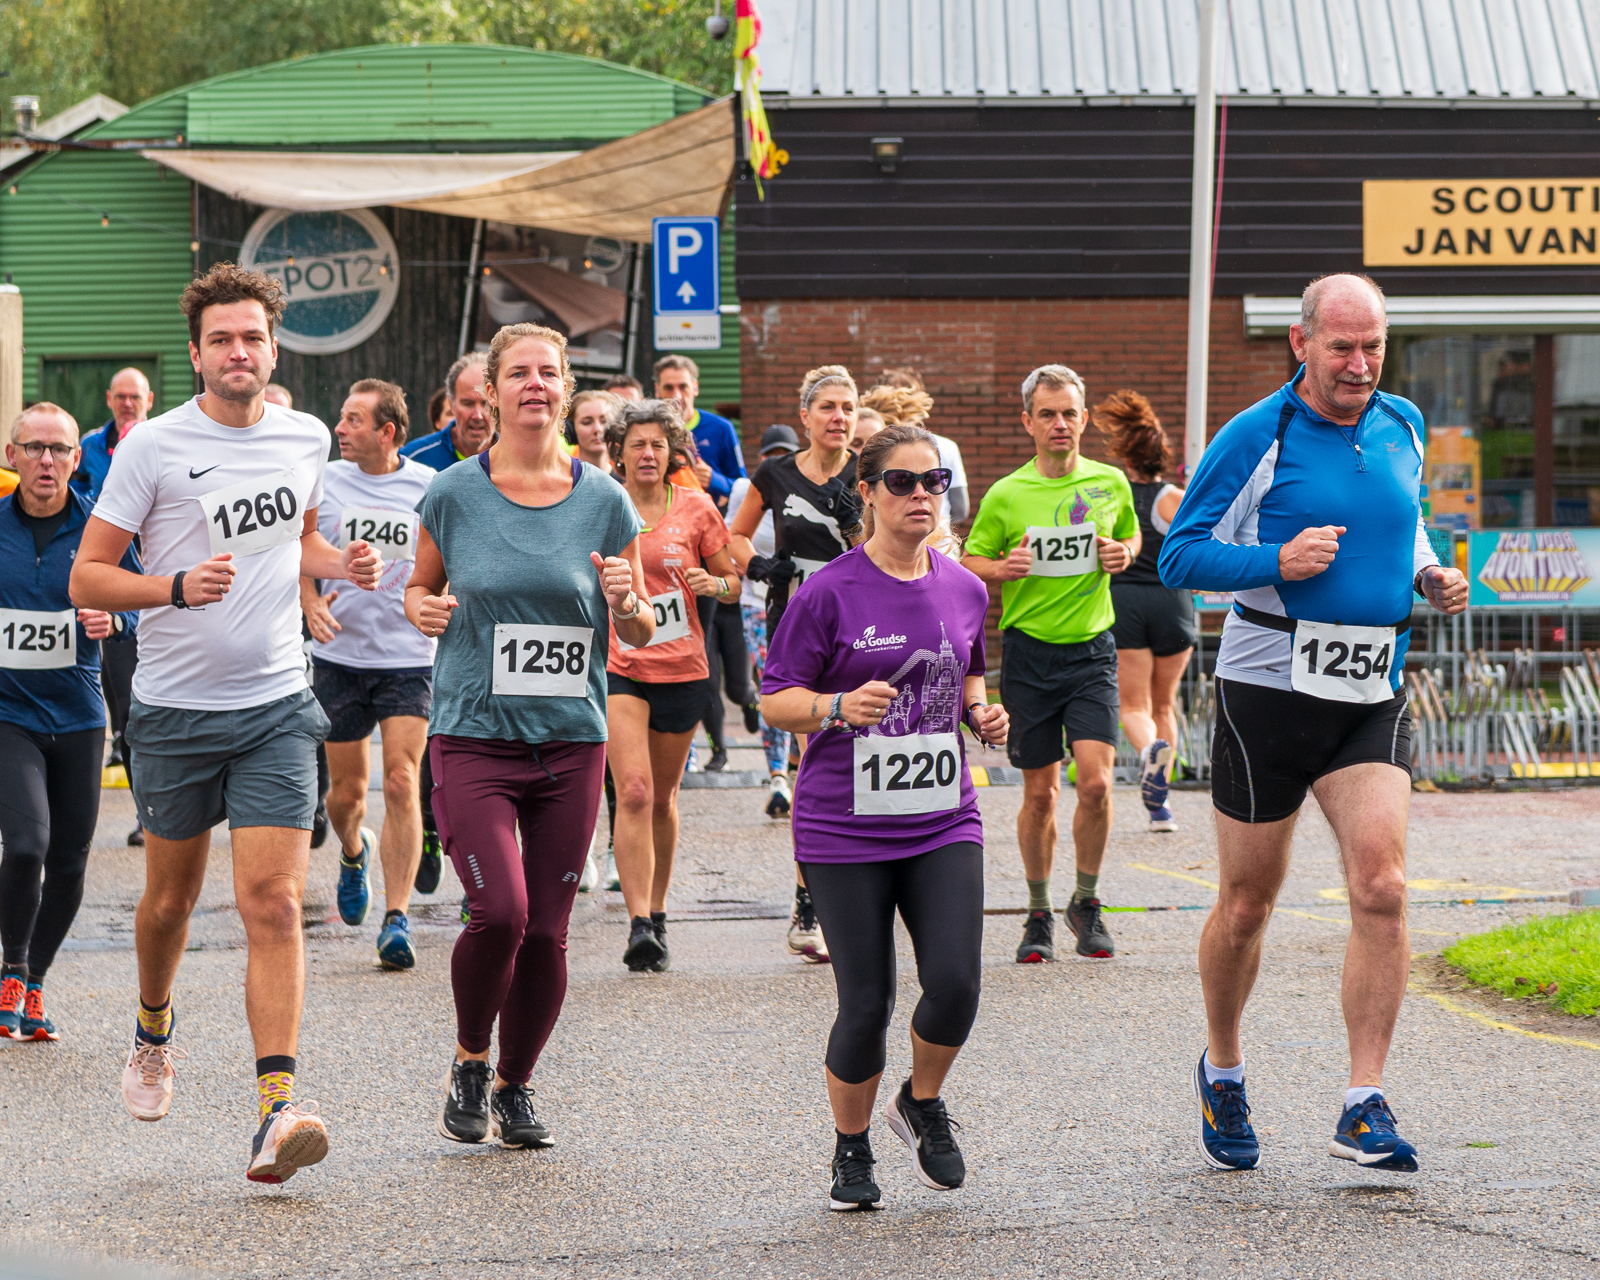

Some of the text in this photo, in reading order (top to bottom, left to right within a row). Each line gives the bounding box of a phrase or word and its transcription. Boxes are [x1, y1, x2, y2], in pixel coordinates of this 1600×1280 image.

[668, 226, 703, 274] P
[1403, 227, 1596, 255] JAN VAN
[213, 486, 297, 539] 1260
[345, 518, 409, 546] 1246
[1031, 533, 1093, 561] 1257
[3, 622, 70, 652] 1251
[852, 633, 908, 650] de Goudse
[500, 638, 585, 676] 1258
[1300, 638, 1390, 681] 1254
[861, 749, 956, 792] 1220
